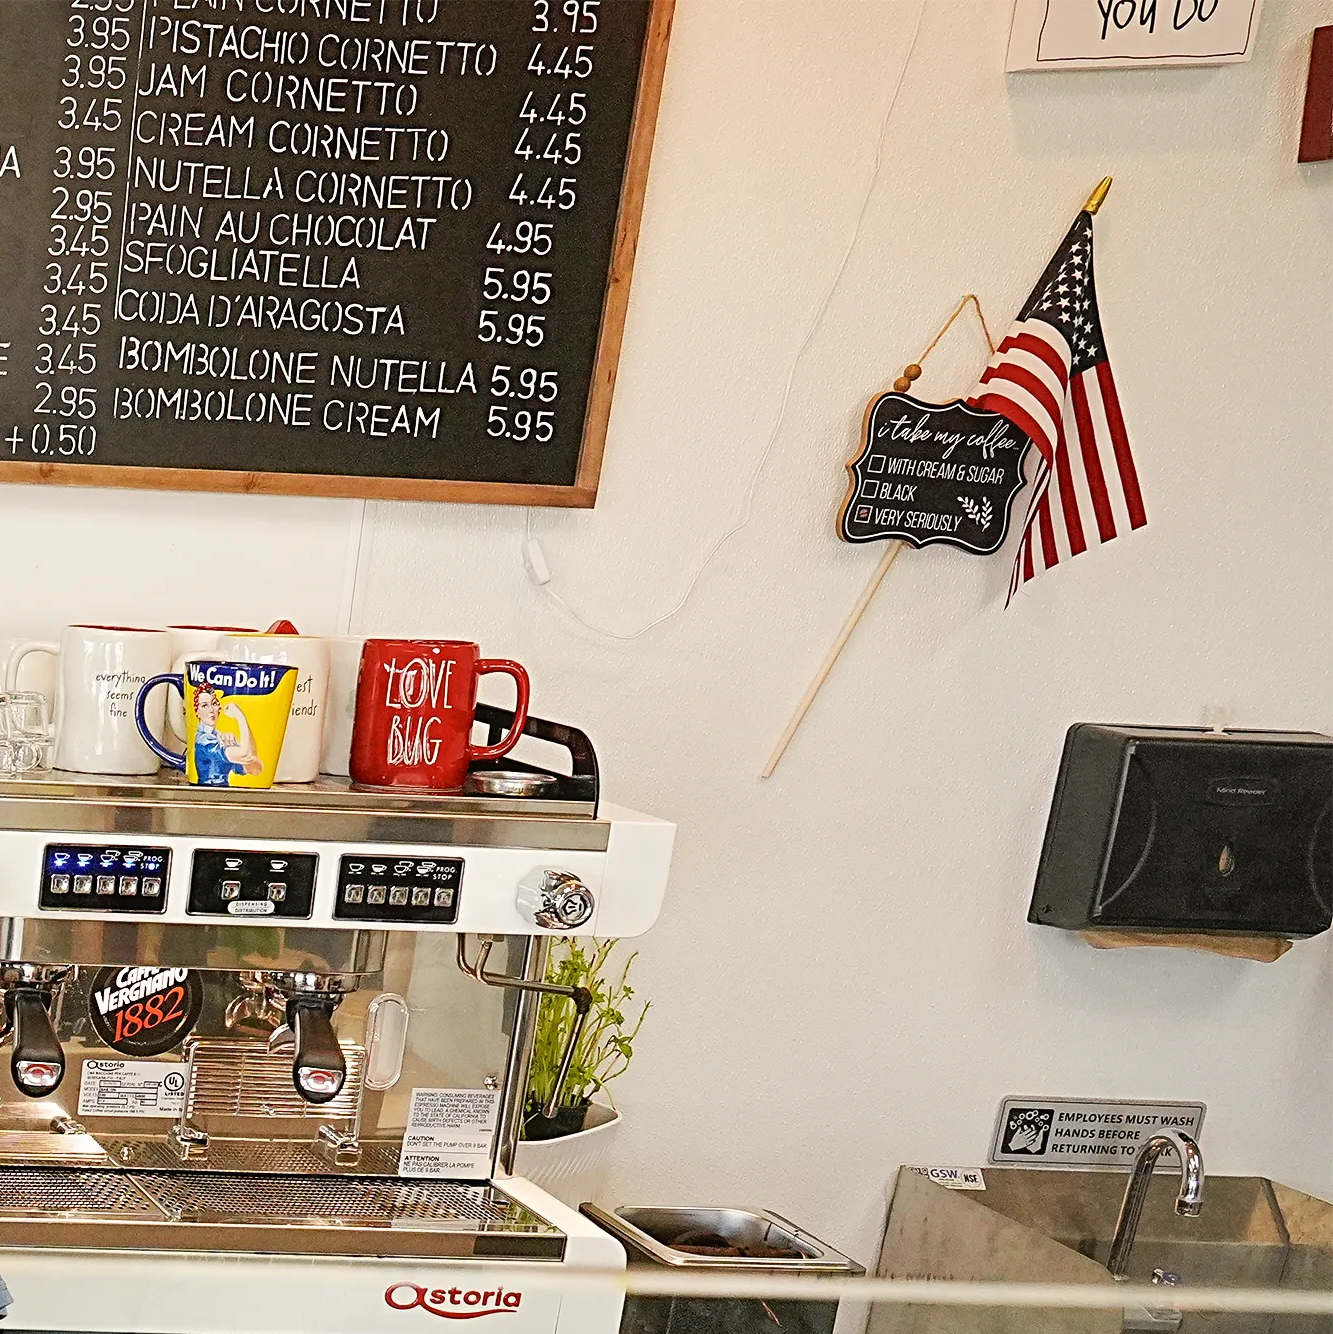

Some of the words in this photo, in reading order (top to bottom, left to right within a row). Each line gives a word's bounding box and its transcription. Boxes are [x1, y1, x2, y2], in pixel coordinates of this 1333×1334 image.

[66, 14, 130, 51] 3.95
[531, 0, 601, 33] 3.95
[149, 15, 309, 65] PISTACHIO
[318, 33, 497, 76] CORNETTO
[527, 43, 594, 80] 4.45
[61, 54, 127, 90] 3.95
[138, 62, 207, 99] JAM
[226, 68, 418, 116] CORNETTO
[518, 90, 587, 126] 4.45
[57, 96, 123, 132] 3.45
[136, 110, 255, 149] CREAM
[268, 120, 449, 162] CORNETTO
[514, 127, 582, 165] 4.45
[52, 146, 116, 180] 3.95
[134, 155, 284, 200] NUTELLA
[295, 170, 472, 211] CORNETTO
[508, 172, 577, 210] 4.45
[50, 186, 113, 224] 2.95
[47, 224, 109, 258] 3.45
[130, 202, 204, 239] PAIN
[214, 210, 261, 244] AU
[269, 213, 437, 251] CHOCOLAT
[485, 220, 554, 256] 4.95
[43, 261, 109, 296] 3.45
[123, 241, 361, 290] SFOGLIATELLA
[483, 267, 553, 305] 5.95
[38, 303, 102, 338] 3.45
[118, 288, 200, 326] CODA
[207, 294, 405, 335] D'ARAGOSTA
[477, 309, 546, 348] 5.95
[34, 342, 97, 375] 3.45
[118, 335, 319, 384] BOMBOLONE
[330, 354, 478, 395] NUTELLA
[490, 364, 558, 403] 5.95
[33, 381, 98, 420] 2.95
[113, 387, 314, 426] BOMBOLONE
[323, 399, 441, 439] CREAM
[486, 405, 555, 442] 5.95
[890, 413, 933, 443] take
[933, 431, 966, 460] my
[887, 457, 917, 476] WITH
[916, 460, 957, 480] CREAM
[956, 464, 967, 481] &
[966, 465, 1005, 485] SUGAR
[880, 482, 918, 502] BLACK
[874, 508, 905, 527] VERY
[903, 510, 963, 532] SERIOUSLY
[189, 664, 205, 684] We
[205, 667, 233, 686] Can
[235, 670, 257, 688] Do
[259, 671, 275, 689] It!
[384, 658, 457, 709] LOVE
[106, 690, 134, 701] seems
[109, 702, 128, 718] fine
[387, 716, 443, 766] BUG
[433, 873, 453, 881] STOP
[94, 968, 189, 1016] VERGNANO
[113, 986, 185, 1043] 1882
[1054, 1128, 1096, 1140] HANDS
[1098, 1129, 1141, 1141] BEFORE
[1058, 1112, 1124, 1125] EMPLOYEES
[1125, 1113, 1158, 1126] MUST
[1159, 1115, 1195, 1126] WASH
[1051, 1143, 1118, 1155] RETURNING
[1120, 1144, 1134, 1156] TO
